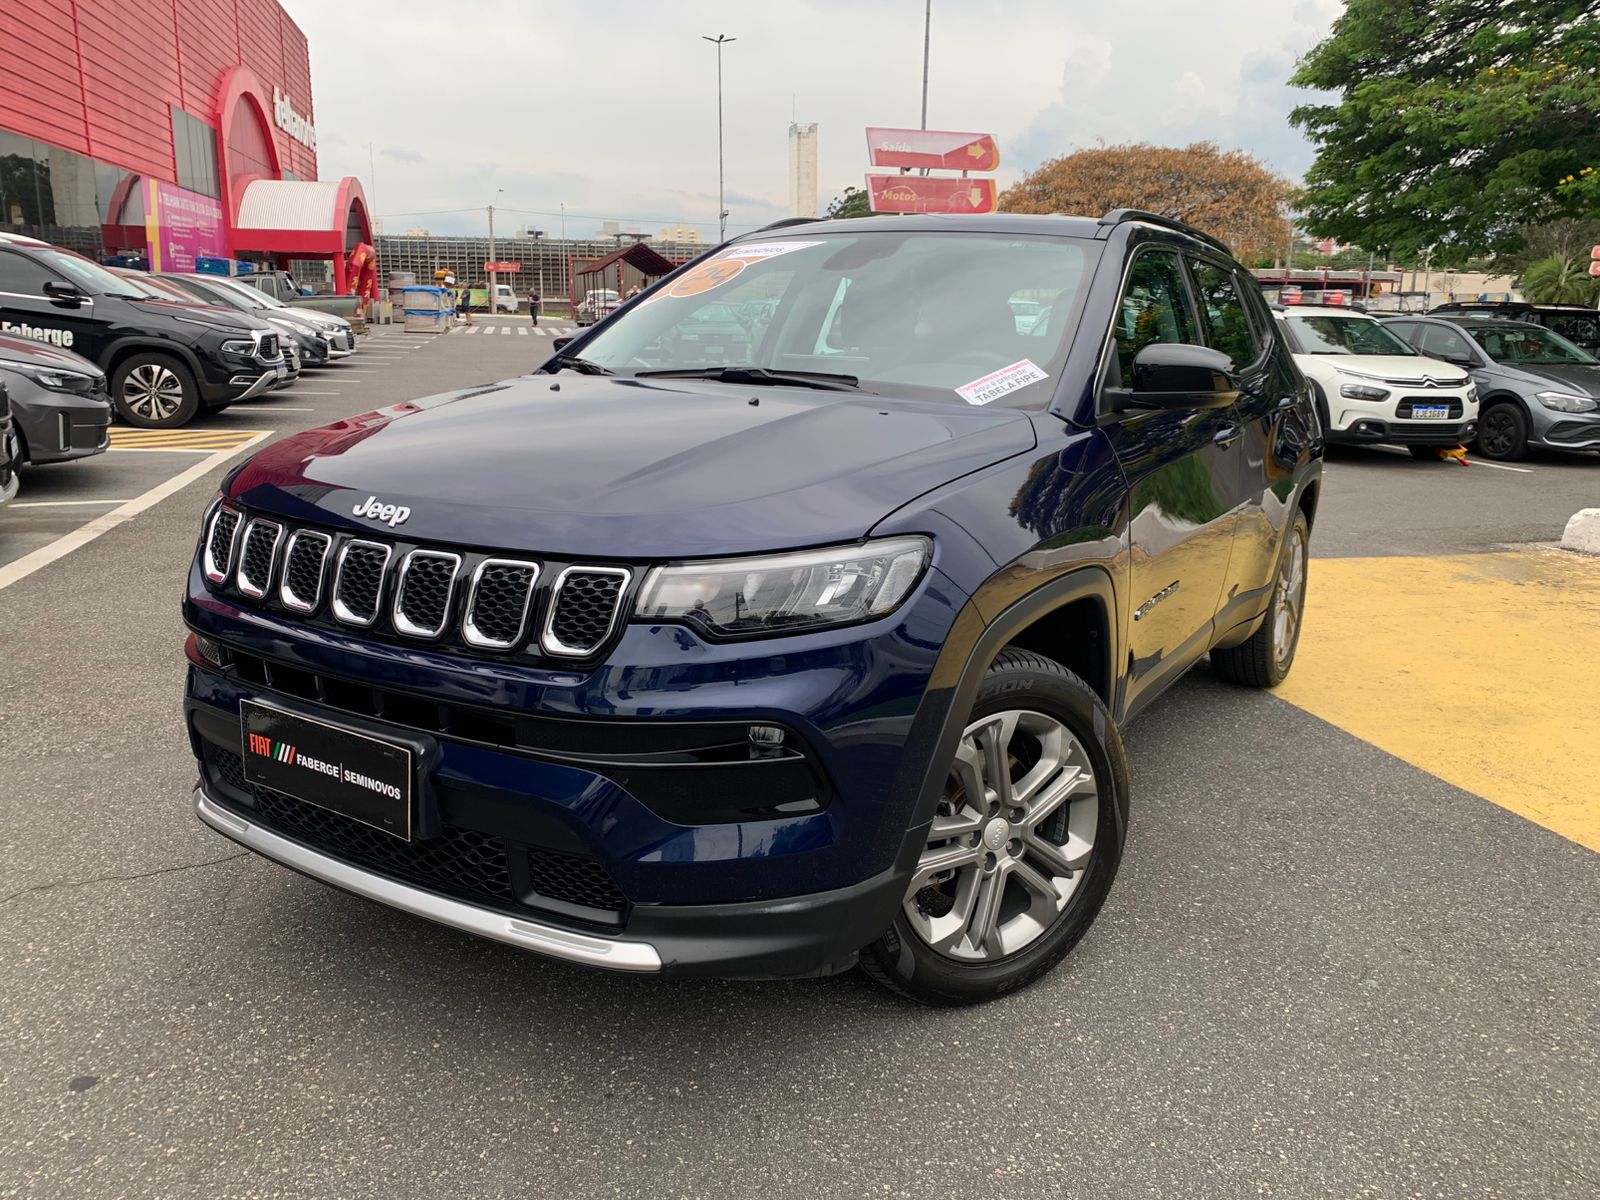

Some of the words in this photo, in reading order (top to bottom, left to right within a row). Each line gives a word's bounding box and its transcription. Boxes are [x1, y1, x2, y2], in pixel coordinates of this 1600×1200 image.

[881, 190, 918, 201] Motos
[976, 383, 1016, 402] TABELA
[1016, 372, 1039, 387] FIPE
[352, 496, 411, 527] Jeep
[248, 733, 272, 758] FIAT
[296, 753, 340, 778] FABERGE
[344, 770, 401, 800] SEMINOVOS
